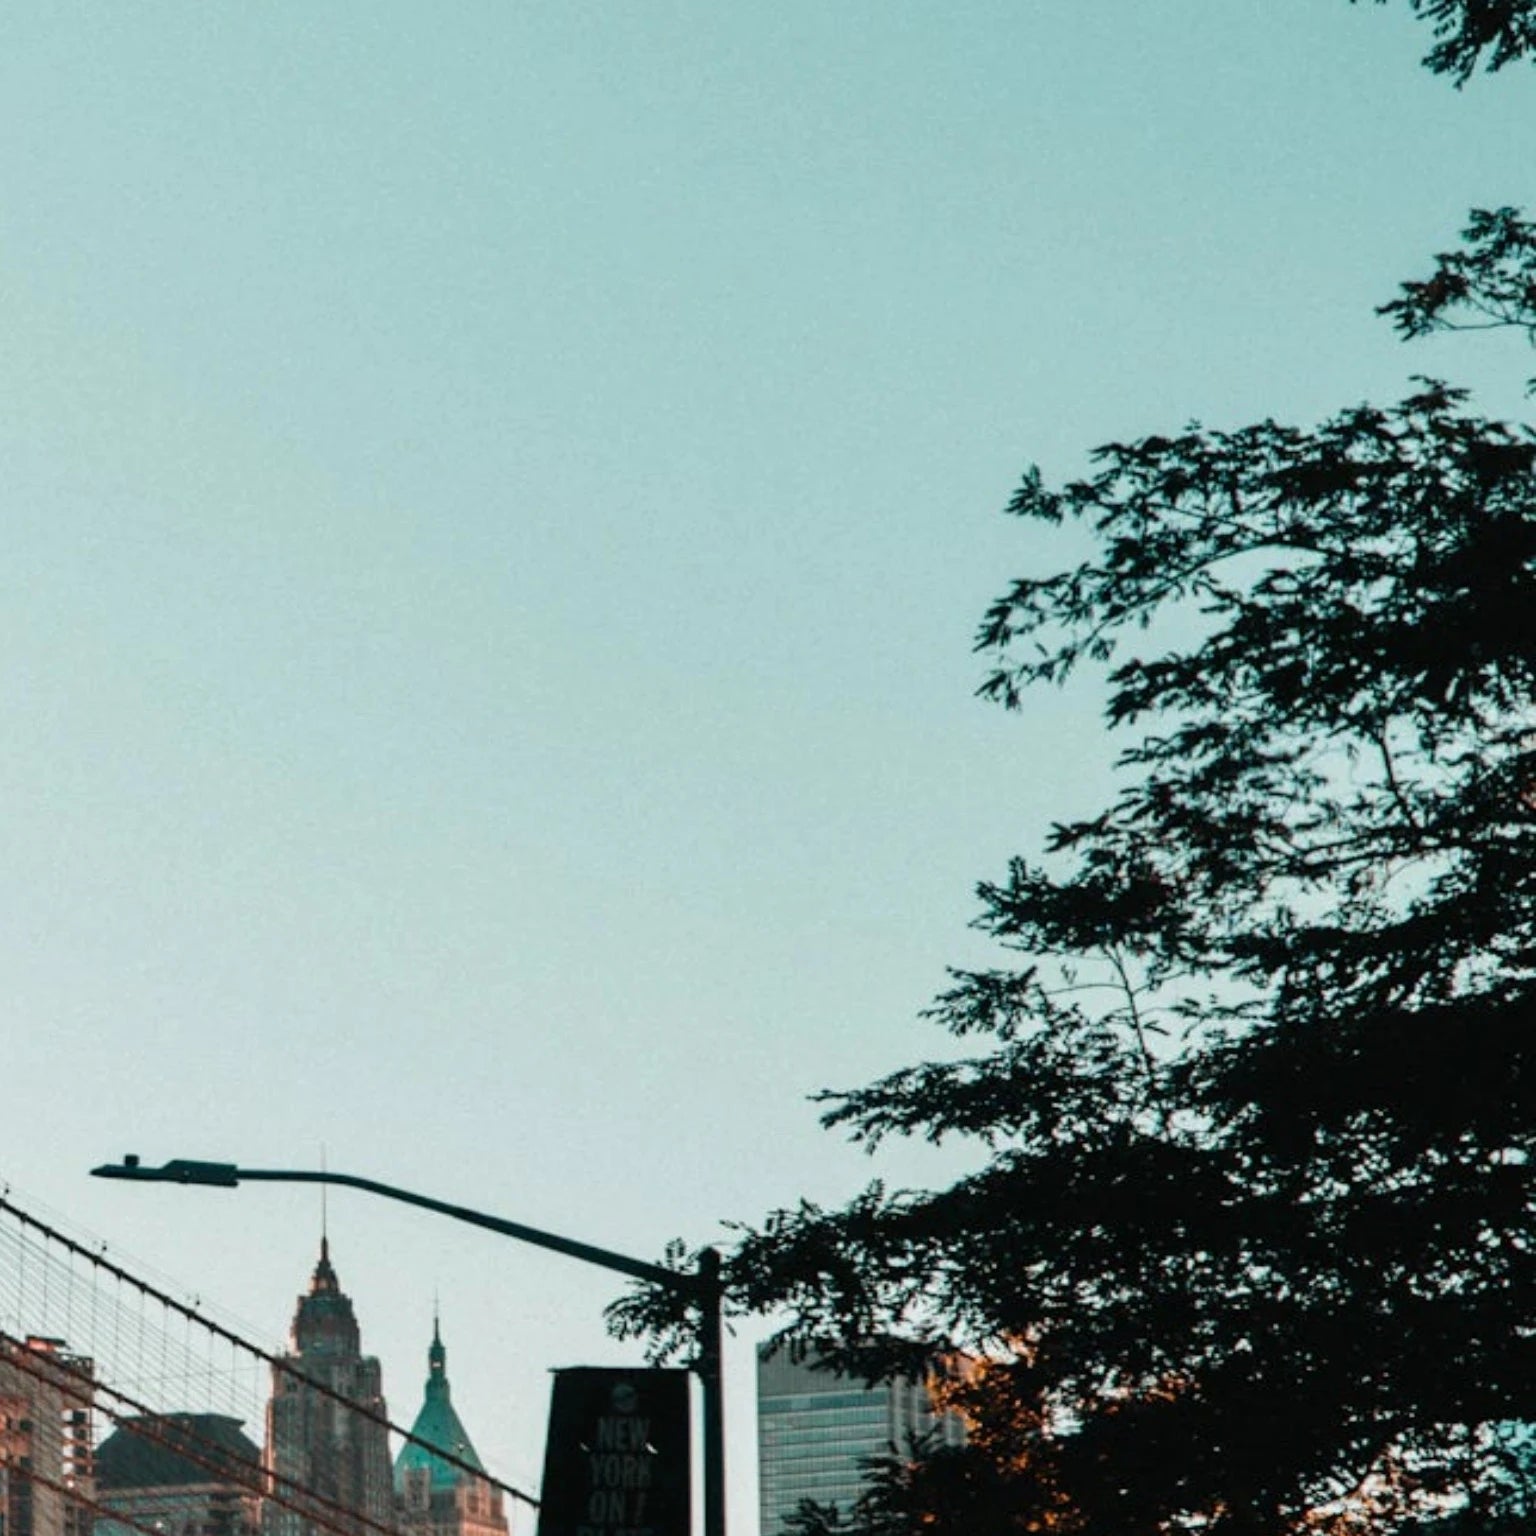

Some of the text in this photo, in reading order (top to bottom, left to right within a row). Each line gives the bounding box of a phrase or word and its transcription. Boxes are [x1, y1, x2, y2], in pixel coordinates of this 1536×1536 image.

[597, 1416, 651, 1452] NEW
[589, 1453, 651, 1489] YORK
[589, 1491, 625, 1523] ON
